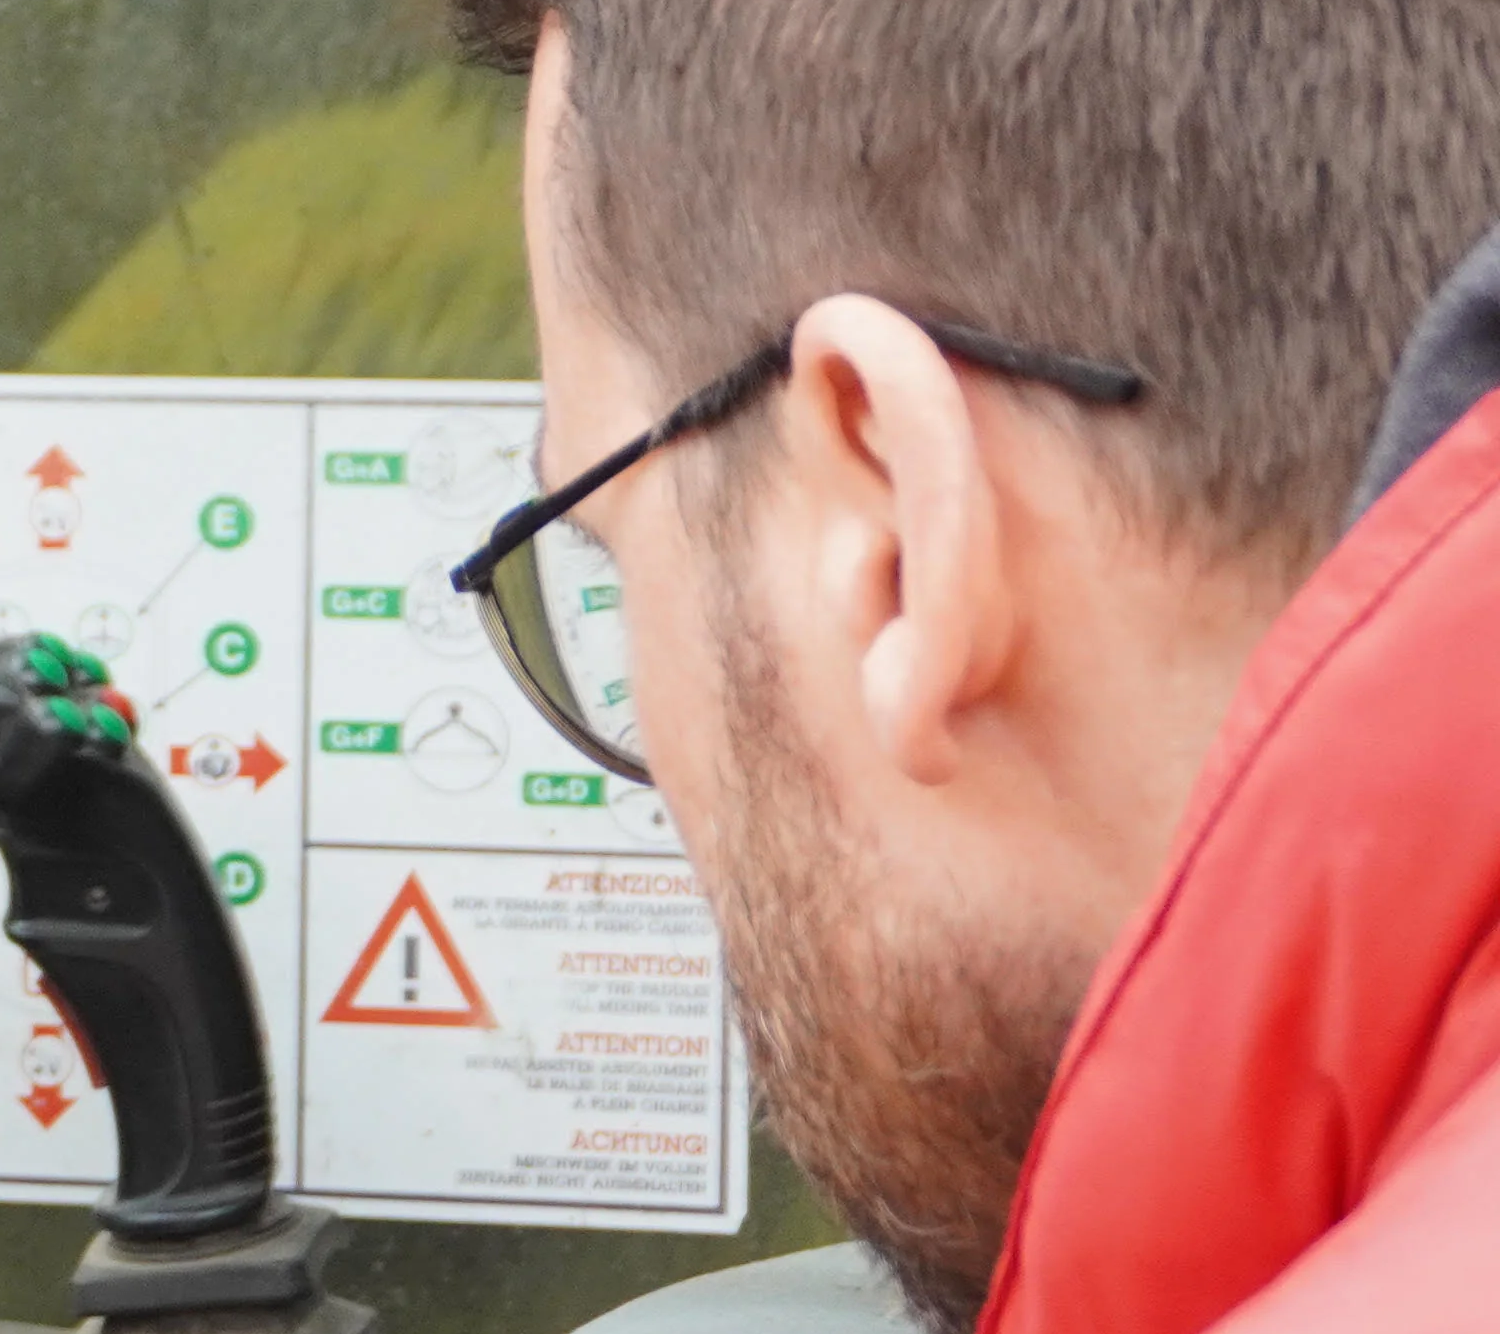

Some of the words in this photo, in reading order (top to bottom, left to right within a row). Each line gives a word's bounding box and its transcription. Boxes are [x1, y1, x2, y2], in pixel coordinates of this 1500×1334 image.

[220, 510, 240, 537] E
[217, 634, 244, 663] C
[227, 866, 255, 893] D
[559, 952, 710, 977] ATTENTION!
[556, 1033, 709, 1057] ATTENTION!
[571, 1130, 707, 1154] ACHTUNG!
